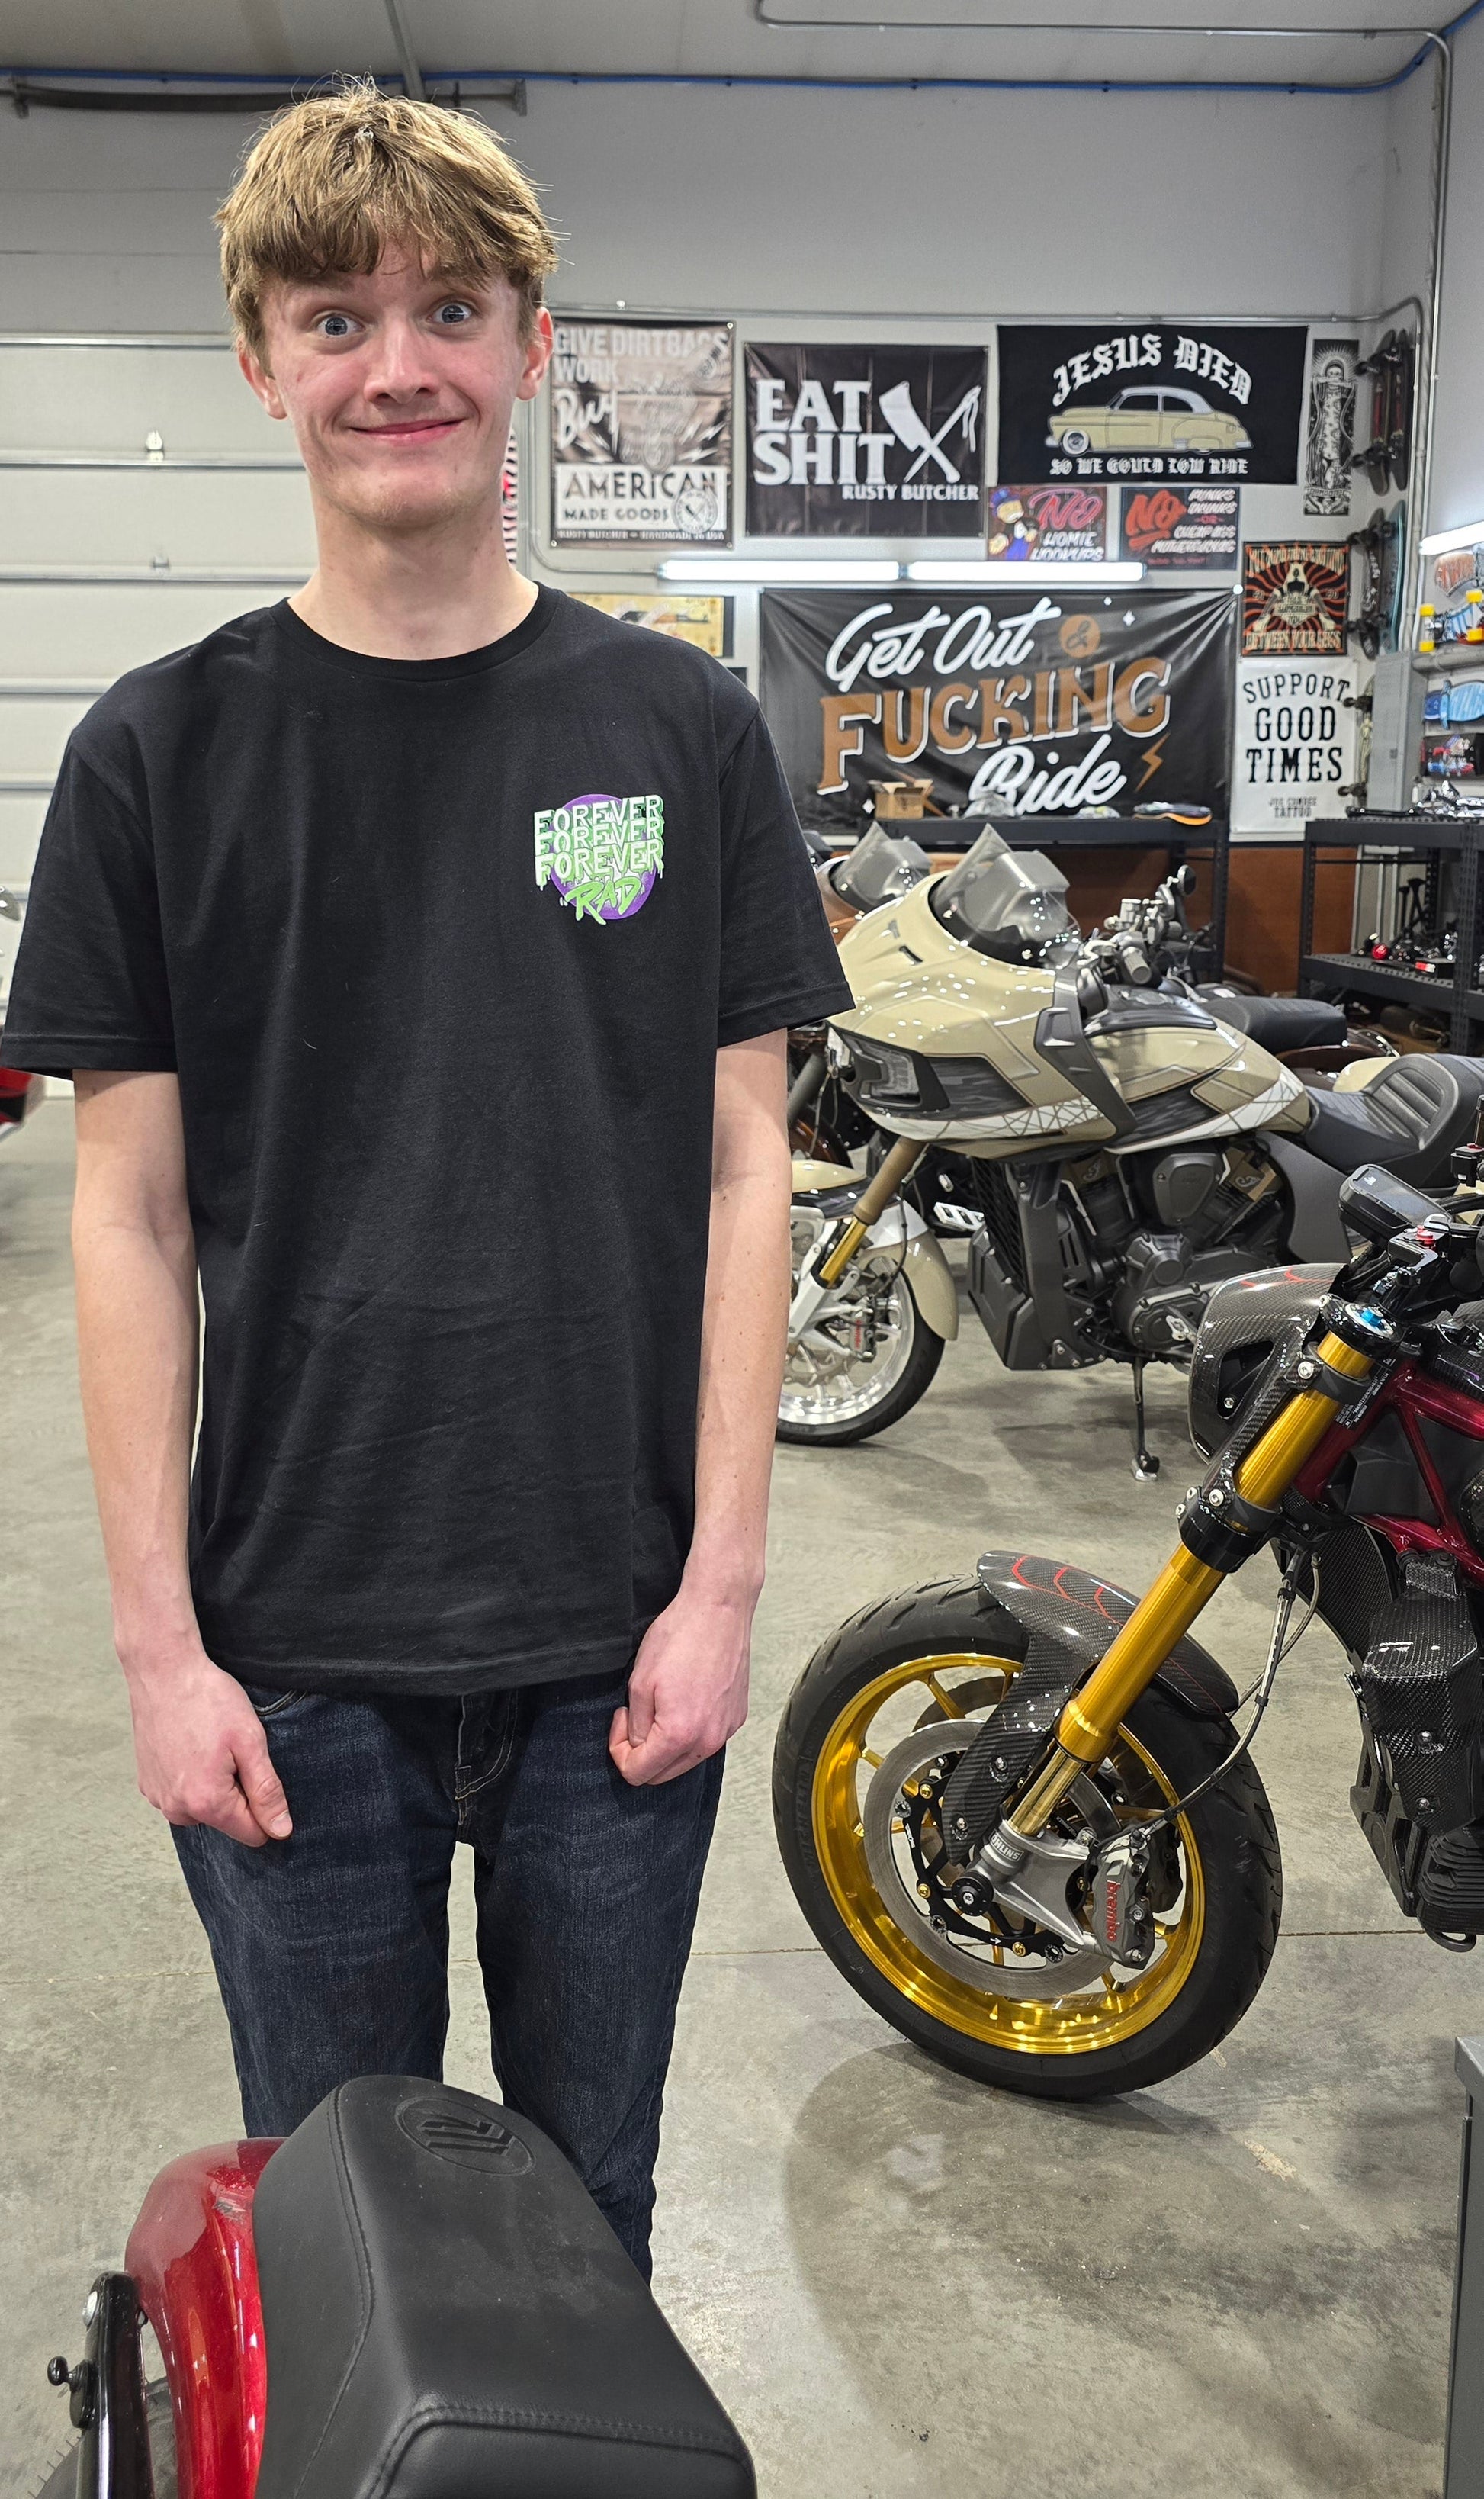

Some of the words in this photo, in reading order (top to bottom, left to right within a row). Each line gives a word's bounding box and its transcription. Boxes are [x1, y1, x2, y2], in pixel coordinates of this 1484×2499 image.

[554, 329, 608, 355] GIVE
[555, 358, 618, 383] WORK
[1052, 333, 1161, 407] JESUS
[1173, 335, 1252, 404] DIED
[756, 380, 871, 432] EAT
[753, 433, 895, 485] SHIT
[1050, 458, 1072, 474] SO
[1077, 458, 1103, 474] WE
[1107, 458, 1164, 474] COULD
[1168, 458, 1205, 474] LOW
[1209, 458, 1248, 474] RIDE
[565, 471, 718, 500] AMERICAN
[842, 484, 897, 500] RUSTY
[901, 484, 979, 501] BUTCHER
[1188, 488, 1236, 501] PUNKS
[564, 509, 608, 521] MADE
[616, 508, 669, 521] GOODS
[1028, 488, 1103, 530] NO
[1125, 489, 1187, 536] NO
[1187, 502, 1237, 514] DRUNKS
[1043, 531, 1097, 547] HOMIE
[1174, 525, 1213, 539] CHEAP
[1030, 546, 1104, 561] HOOKUPS
[824, 603, 951, 692] Get
[933, 596, 1062, 674] Out
[1243, 674, 1350, 703] SUPPORT
[817, 657, 1172, 796] FUCKING
[1255, 706, 1336, 741] GOOD
[968, 733, 1127, 817] Ride
[1246, 747, 1342, 783] TIMES
[534, 794, 663, 834] FOREVER
[535, 817, 665, 856] FOREVER
[535, 839, 664, 891] FOREVER
[1105, 1879, 1121, 1942] brembo
